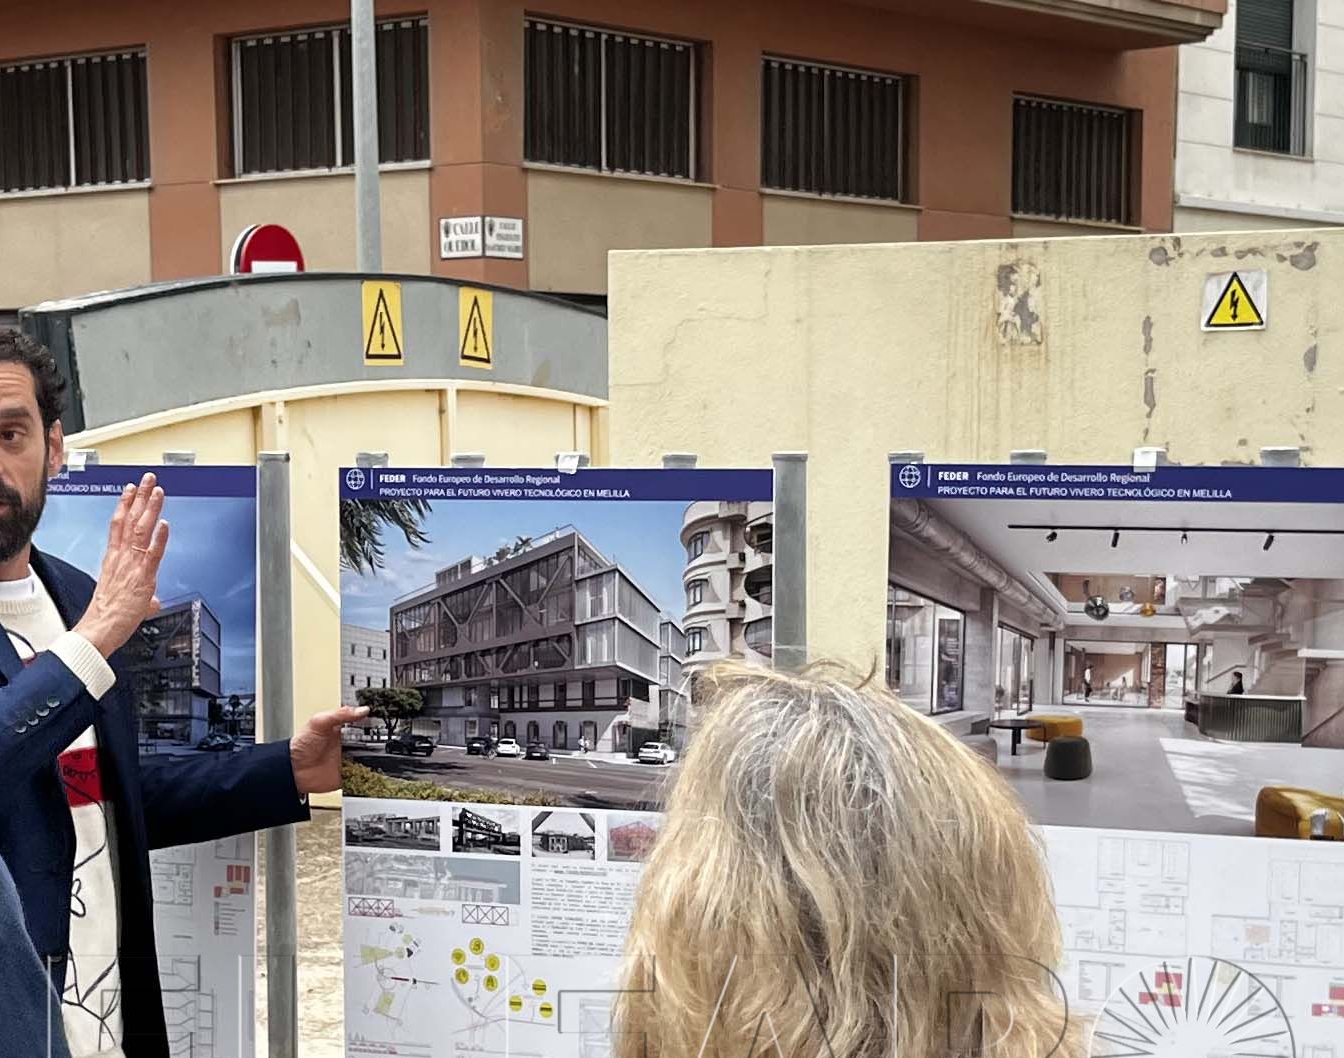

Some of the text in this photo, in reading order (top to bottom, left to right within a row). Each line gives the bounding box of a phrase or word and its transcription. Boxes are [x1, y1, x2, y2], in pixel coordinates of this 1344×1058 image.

[379, 474, 560, 486] FEDER Fondo Europeo de Desarrollo Regional
[938, 471, 1150, 484] FEDER Fondo Europeo de Desarrollo Regional
[379, 487, 630, 498] PROYECTO PARA EL FUTURO VIVERO TECNOLÓGICO EN MELILLA
[937, 486, 1232, 498] PROYECTO PARA EL FUTURO VIVERO TECNOLÓGICO EN MELILLA
